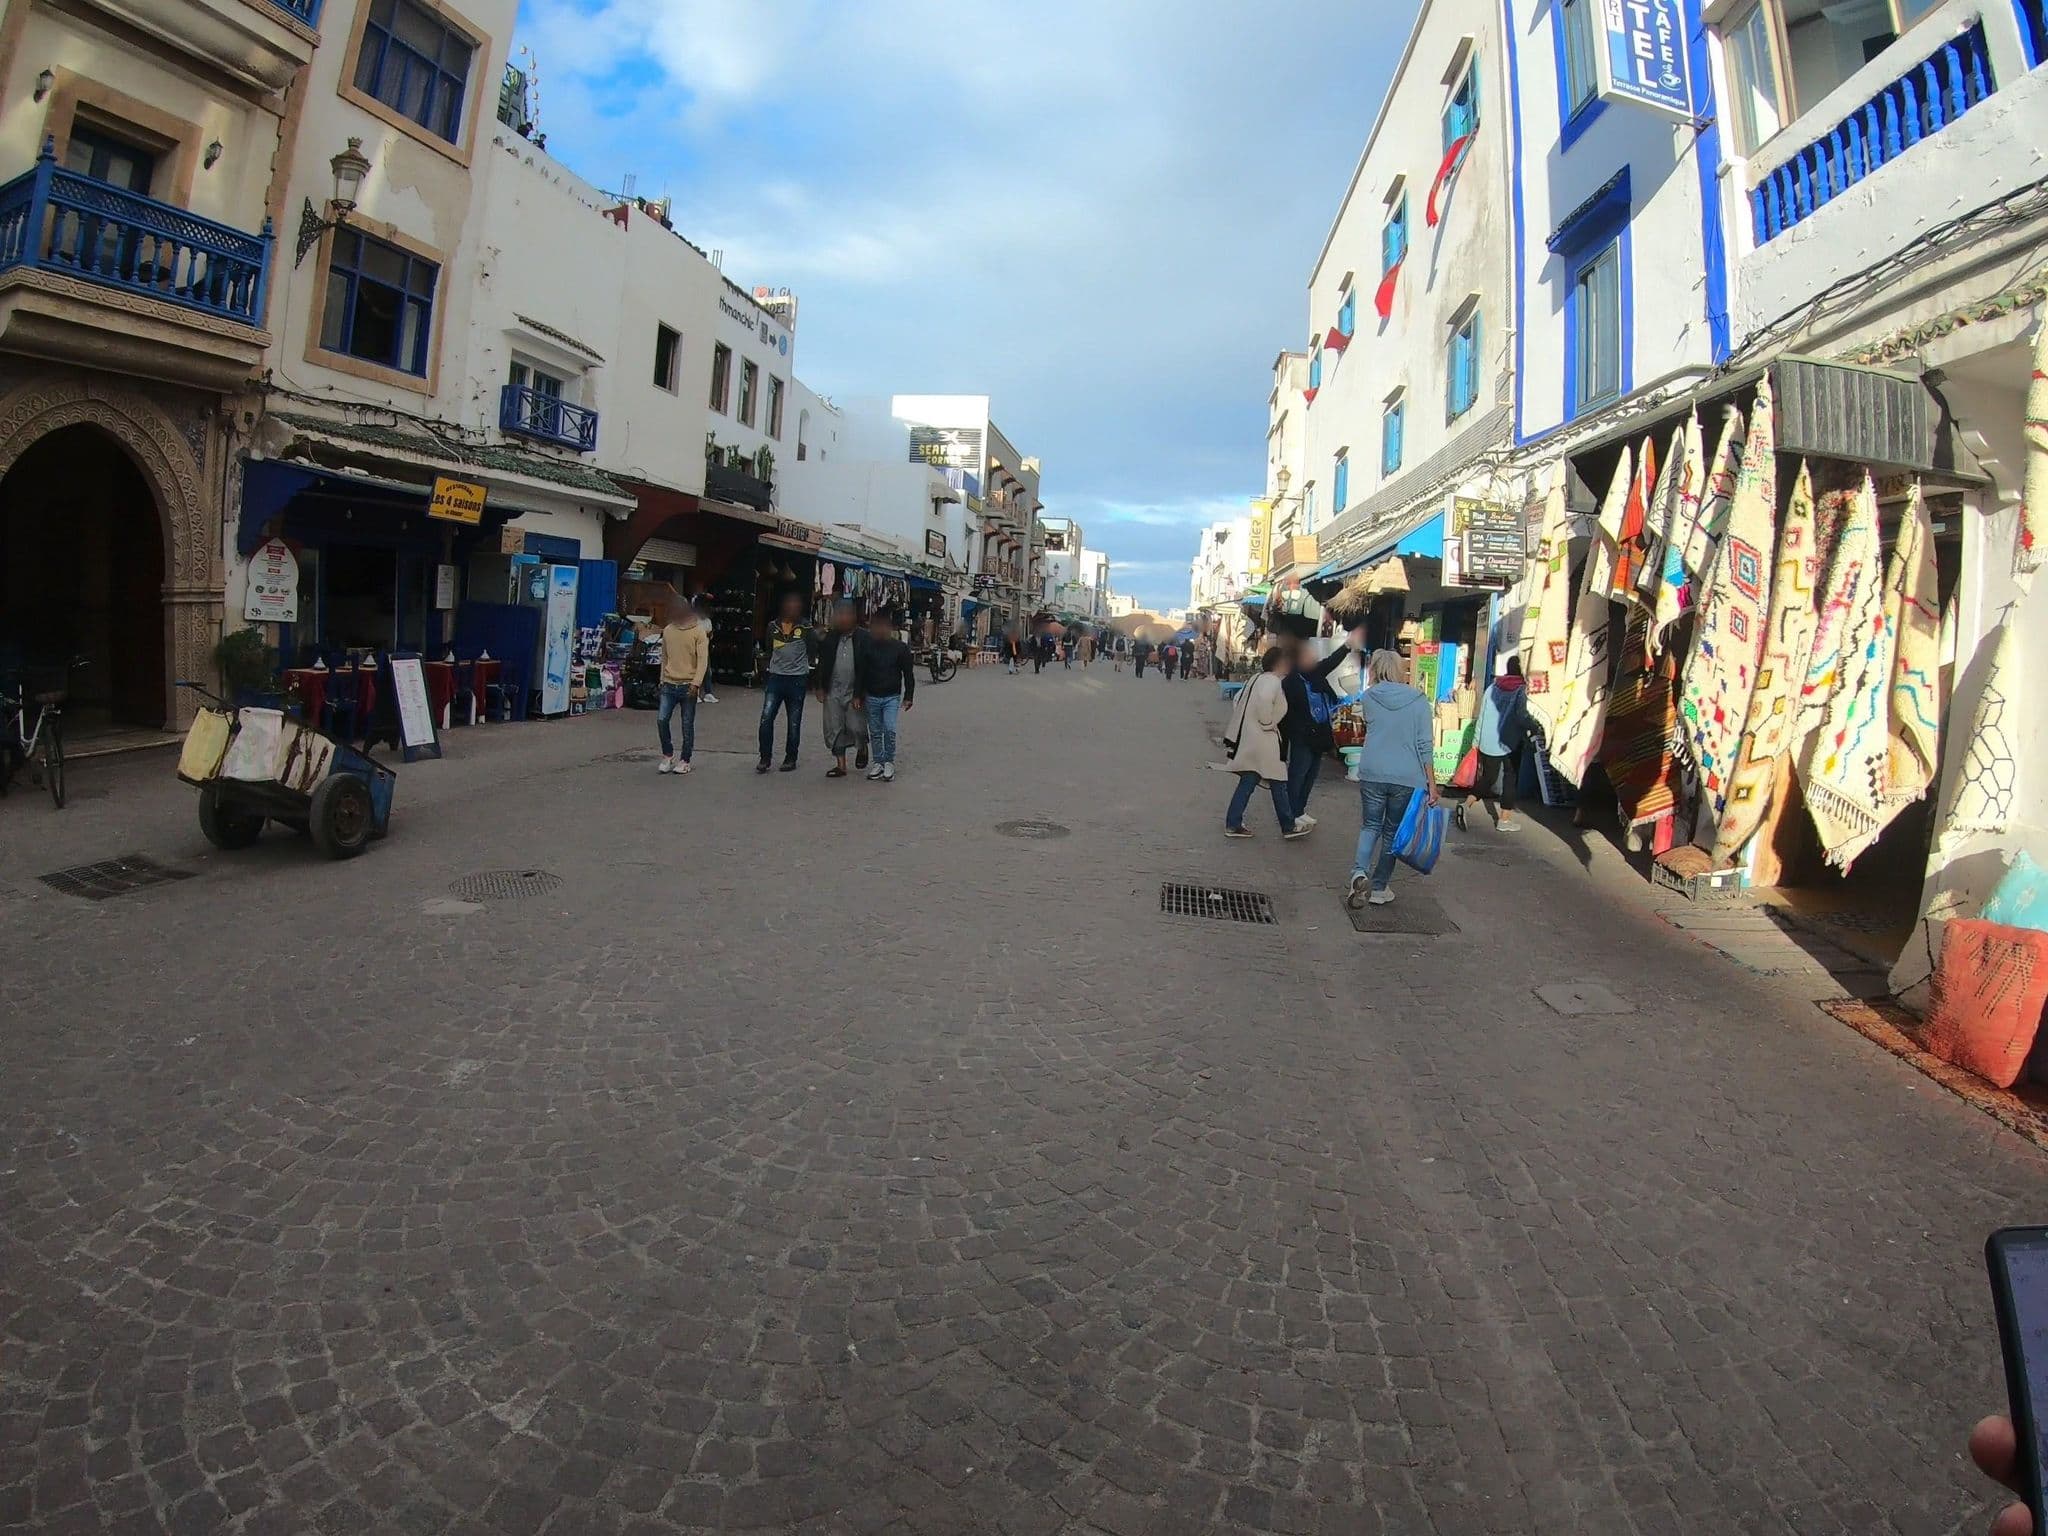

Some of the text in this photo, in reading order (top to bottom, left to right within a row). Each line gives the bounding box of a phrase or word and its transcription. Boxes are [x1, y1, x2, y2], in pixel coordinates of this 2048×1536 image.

[1627, 0, 1658, 88] TEL
[446, 495, 452, 506] 4
[1250, 520, 1262, 560] PIGIER
